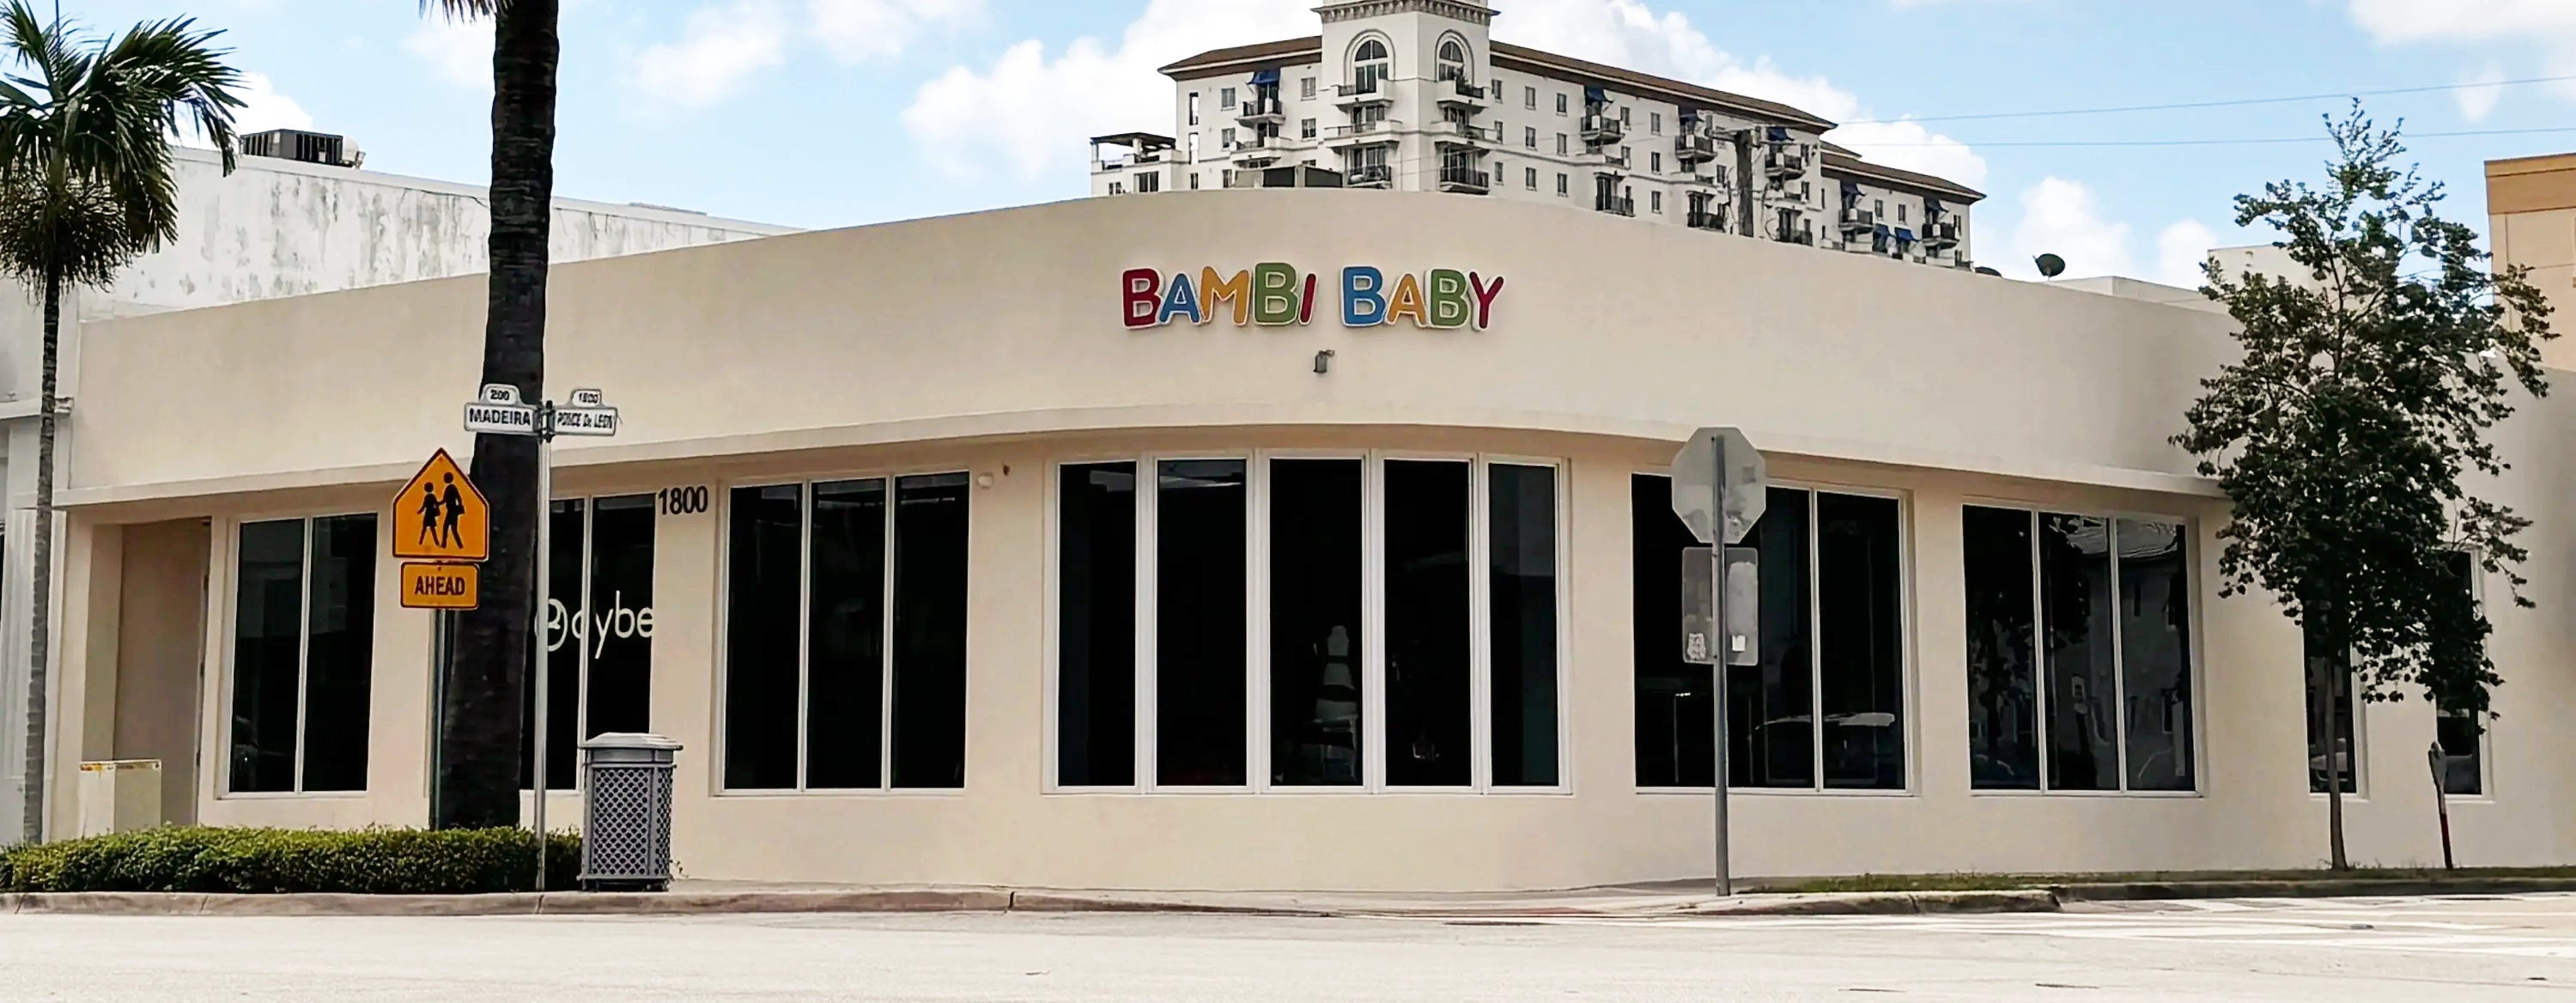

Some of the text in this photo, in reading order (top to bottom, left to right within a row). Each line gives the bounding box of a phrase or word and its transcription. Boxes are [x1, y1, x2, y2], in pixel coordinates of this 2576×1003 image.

[1121, 262, 1504, 331] BAMBI BABY
[490, 389, 510, 400] 200
[469, 408, 531, 426] MADEIRA
[658, 485, 708, 515] 1800
[414, 576, 465, 597] AHEAD
